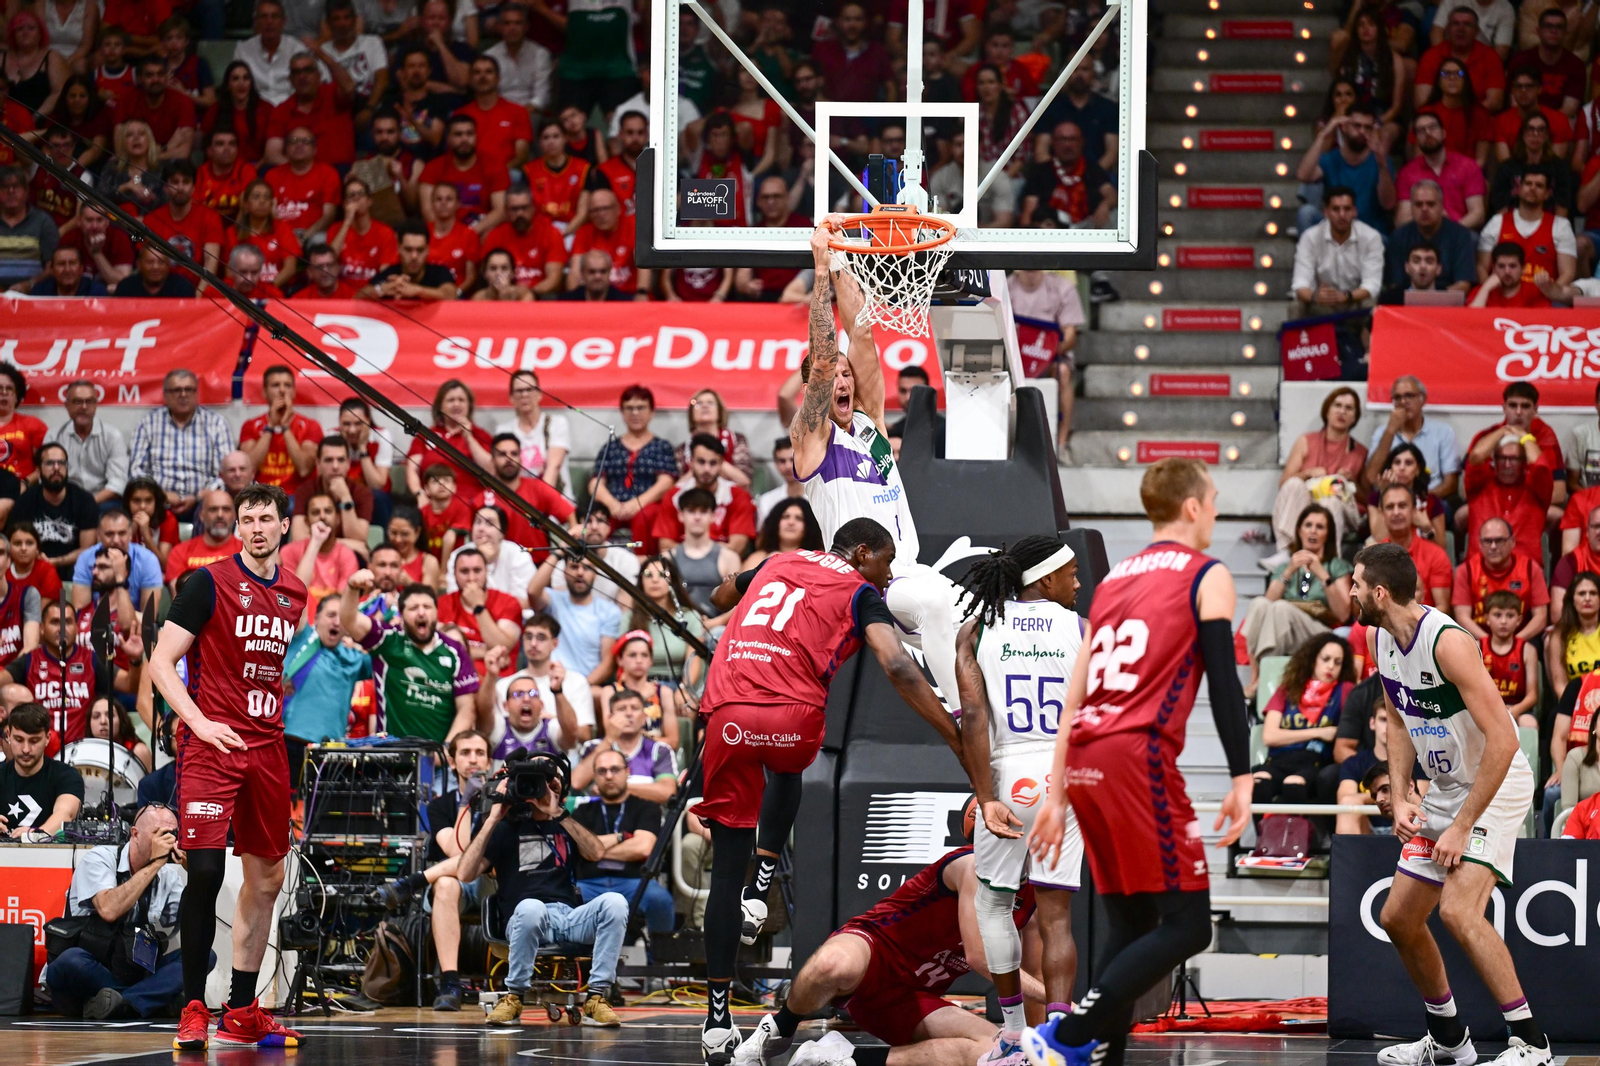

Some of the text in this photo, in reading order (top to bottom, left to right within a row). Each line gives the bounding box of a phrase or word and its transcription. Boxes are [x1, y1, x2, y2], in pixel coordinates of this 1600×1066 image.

[687, 196, 723, 204] PLAYOFF
[433, 326, 928, 371] superDumo
[1287, 342, 1330, 361] MÓDULO
[741, 582, 806, 632] 21
[235, 615, 295, 643] UCAM
[1012, 617, 1053, 633] PERRY
[244, 640, 285, 657] MURCIA
[735, 640, 791, 656] Ayuntamiento
[742, 651, 772, 663] Murcia
[1087, 619, 1150, 696] 22
[247, 690, 277, 718] 00
[1005, 674, 1065, 735] 55
[743, 730, 802, 742] Costa Cálida
[1428, 750, 1452, 775] 45
[914, 961, 950, 987] 14
